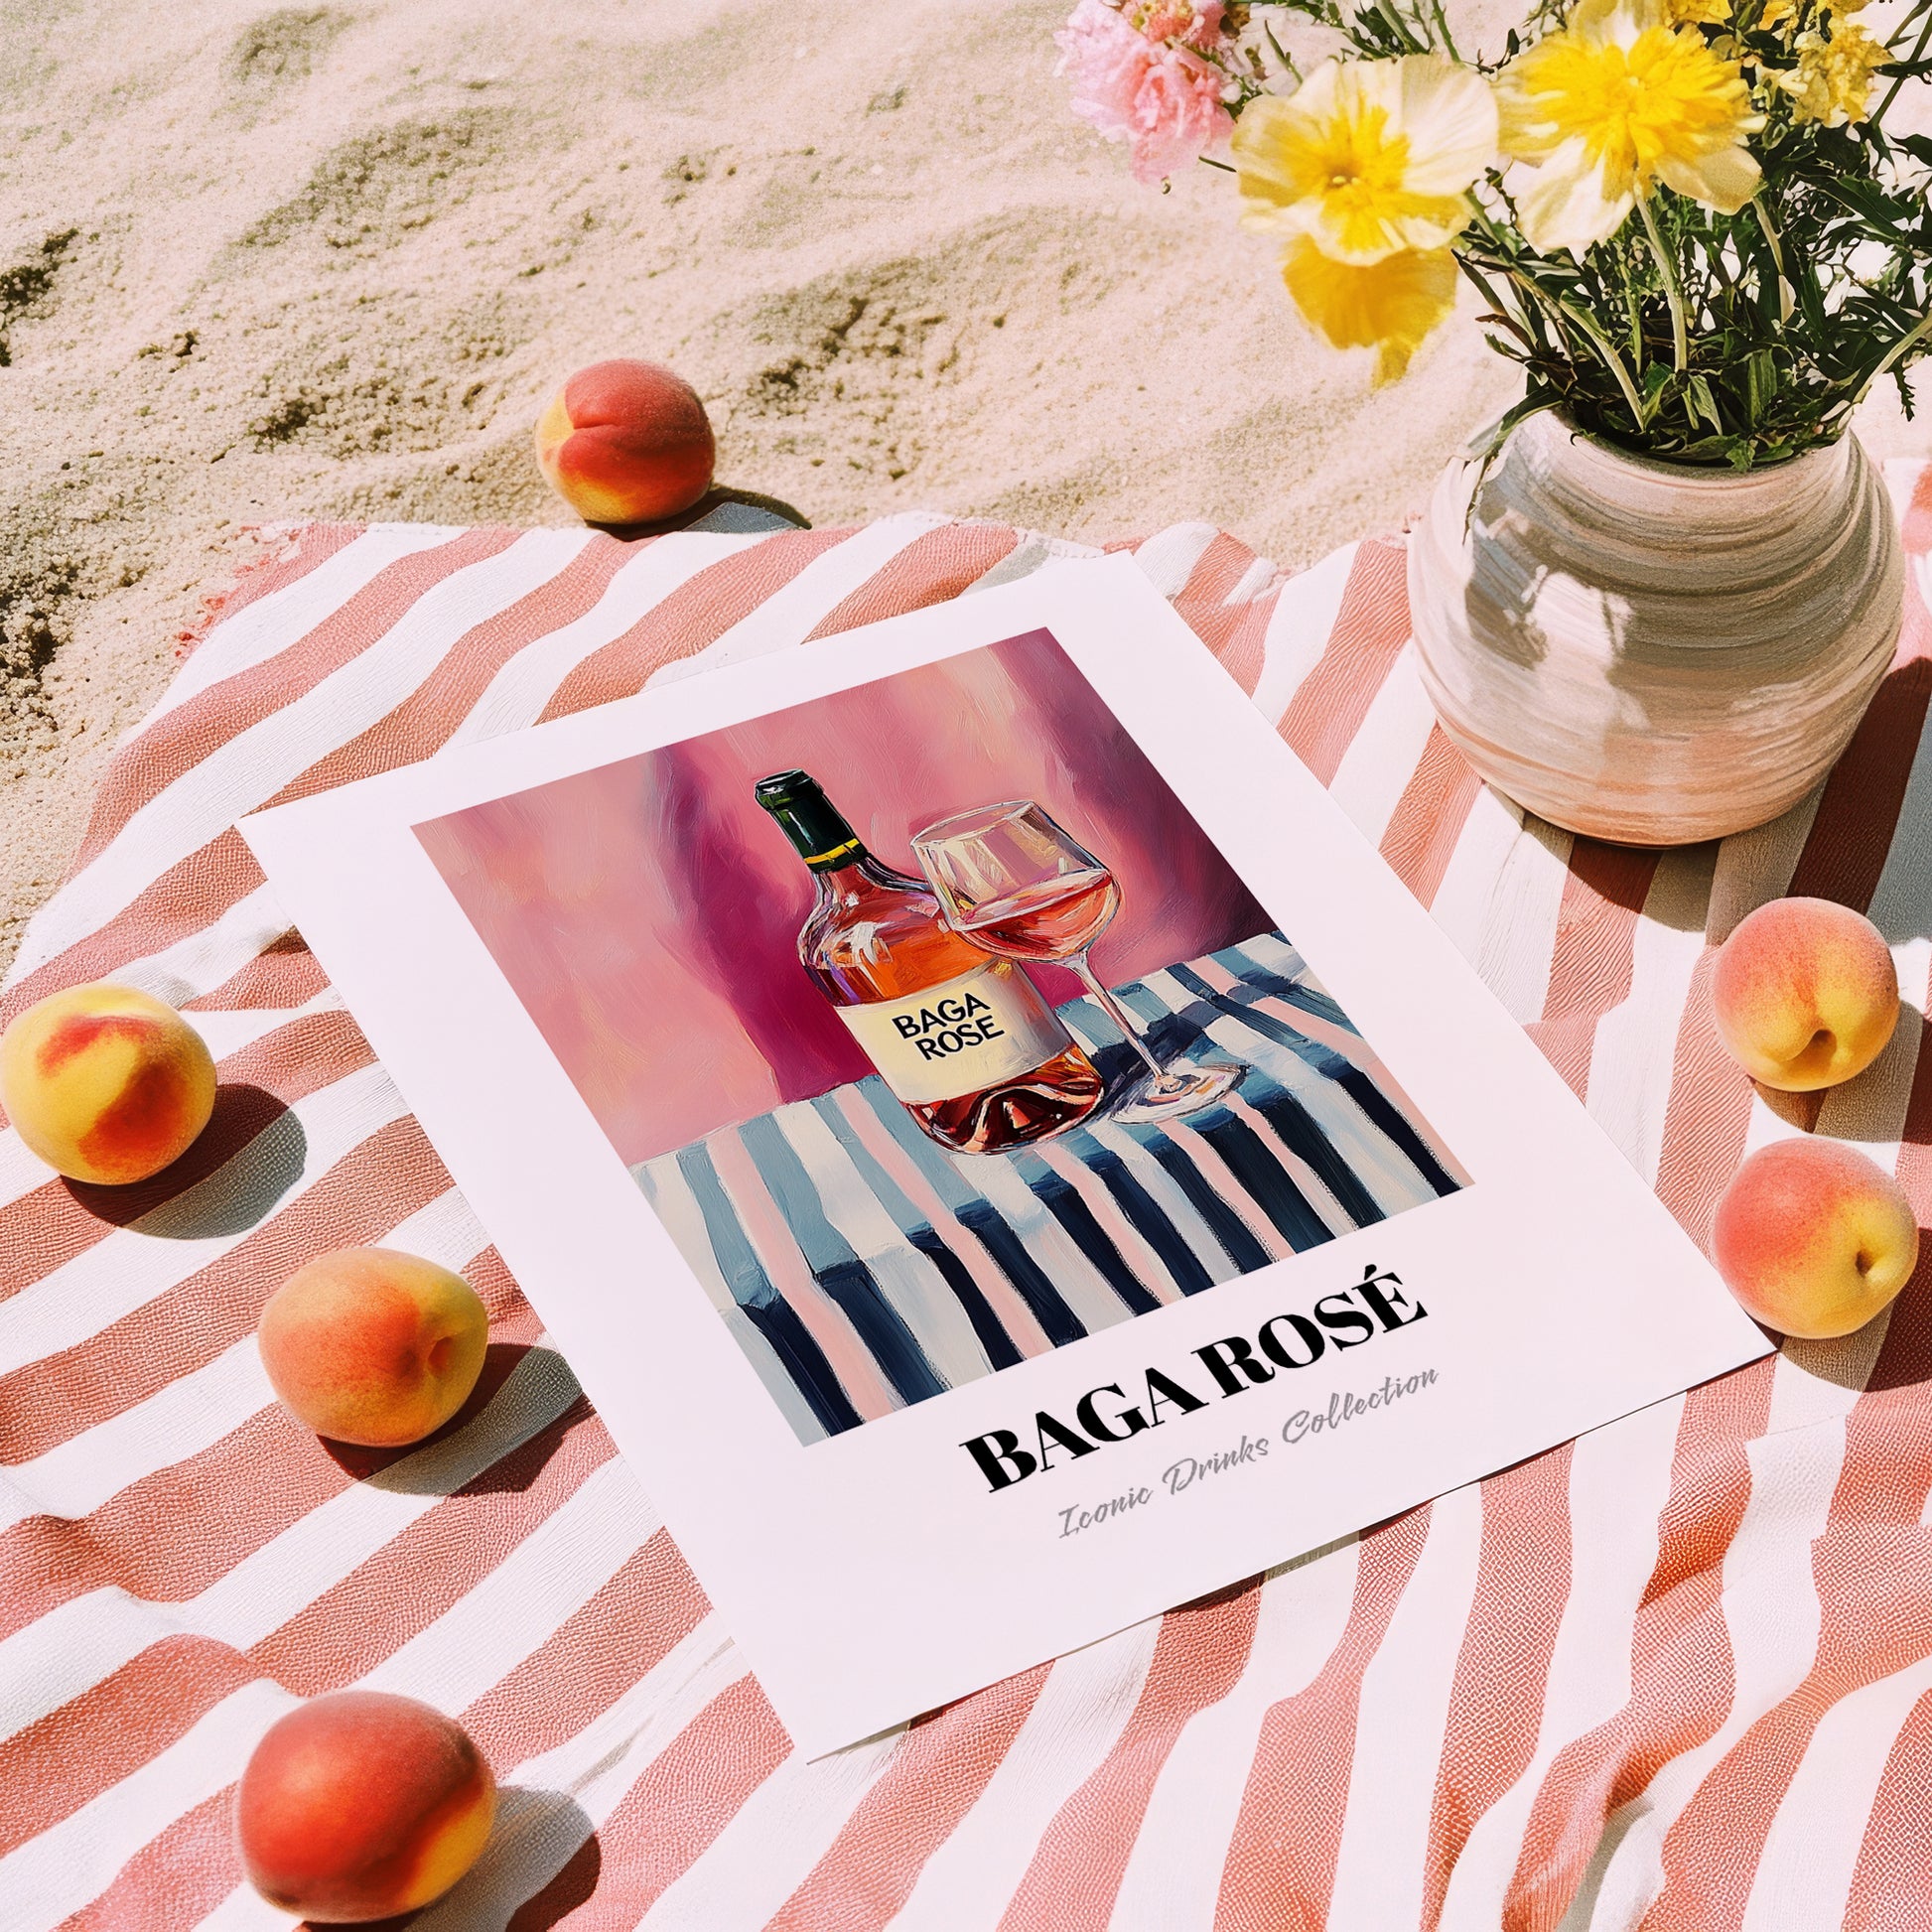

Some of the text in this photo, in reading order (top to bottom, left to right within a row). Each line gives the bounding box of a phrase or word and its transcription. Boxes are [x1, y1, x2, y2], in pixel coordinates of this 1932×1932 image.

[892, 993, 991, 1038] BAGA
[914, 1015, 1005, 1060] ROSE
[959, 1264, 1429, 1494] BAGA ROSÉ
[1058, 1368, 1441, 1540] Iconic Drinks Collection
